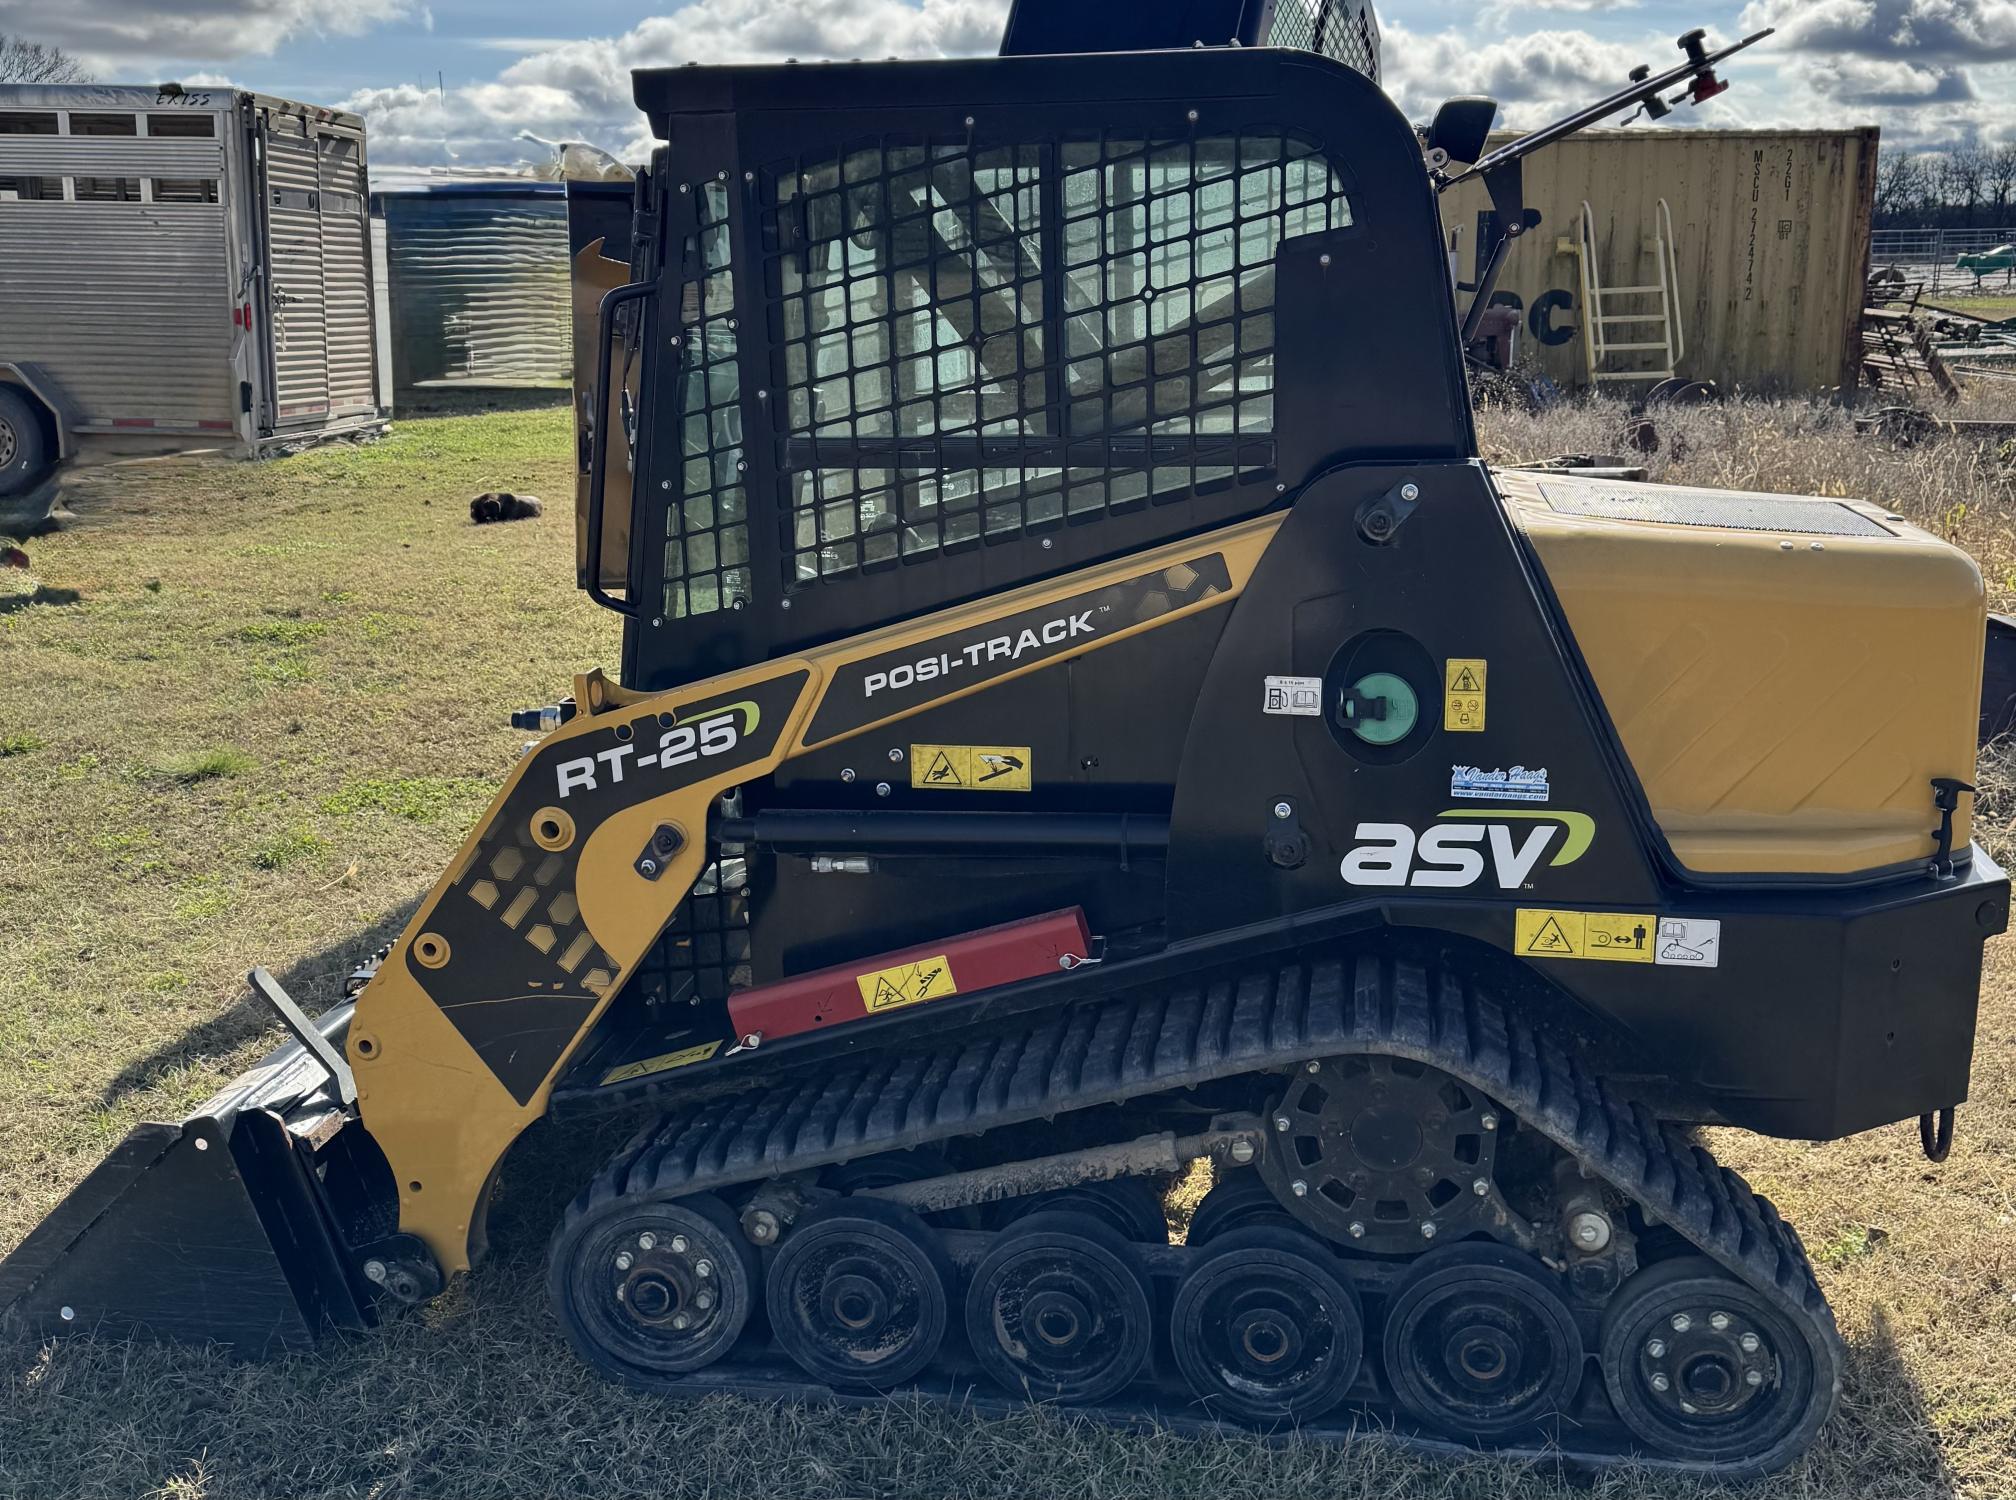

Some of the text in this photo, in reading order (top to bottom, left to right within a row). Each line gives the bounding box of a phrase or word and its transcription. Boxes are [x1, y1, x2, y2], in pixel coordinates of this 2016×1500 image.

[1752, 149, 1764, 202] MSCU
[1784, 148, 1793, 202] 22G1
[863, 609, 1096, 698] POSI-TRACK
[556, 714, 737, 799] RT-25
[1466, 767, 1507, 782] Vander
